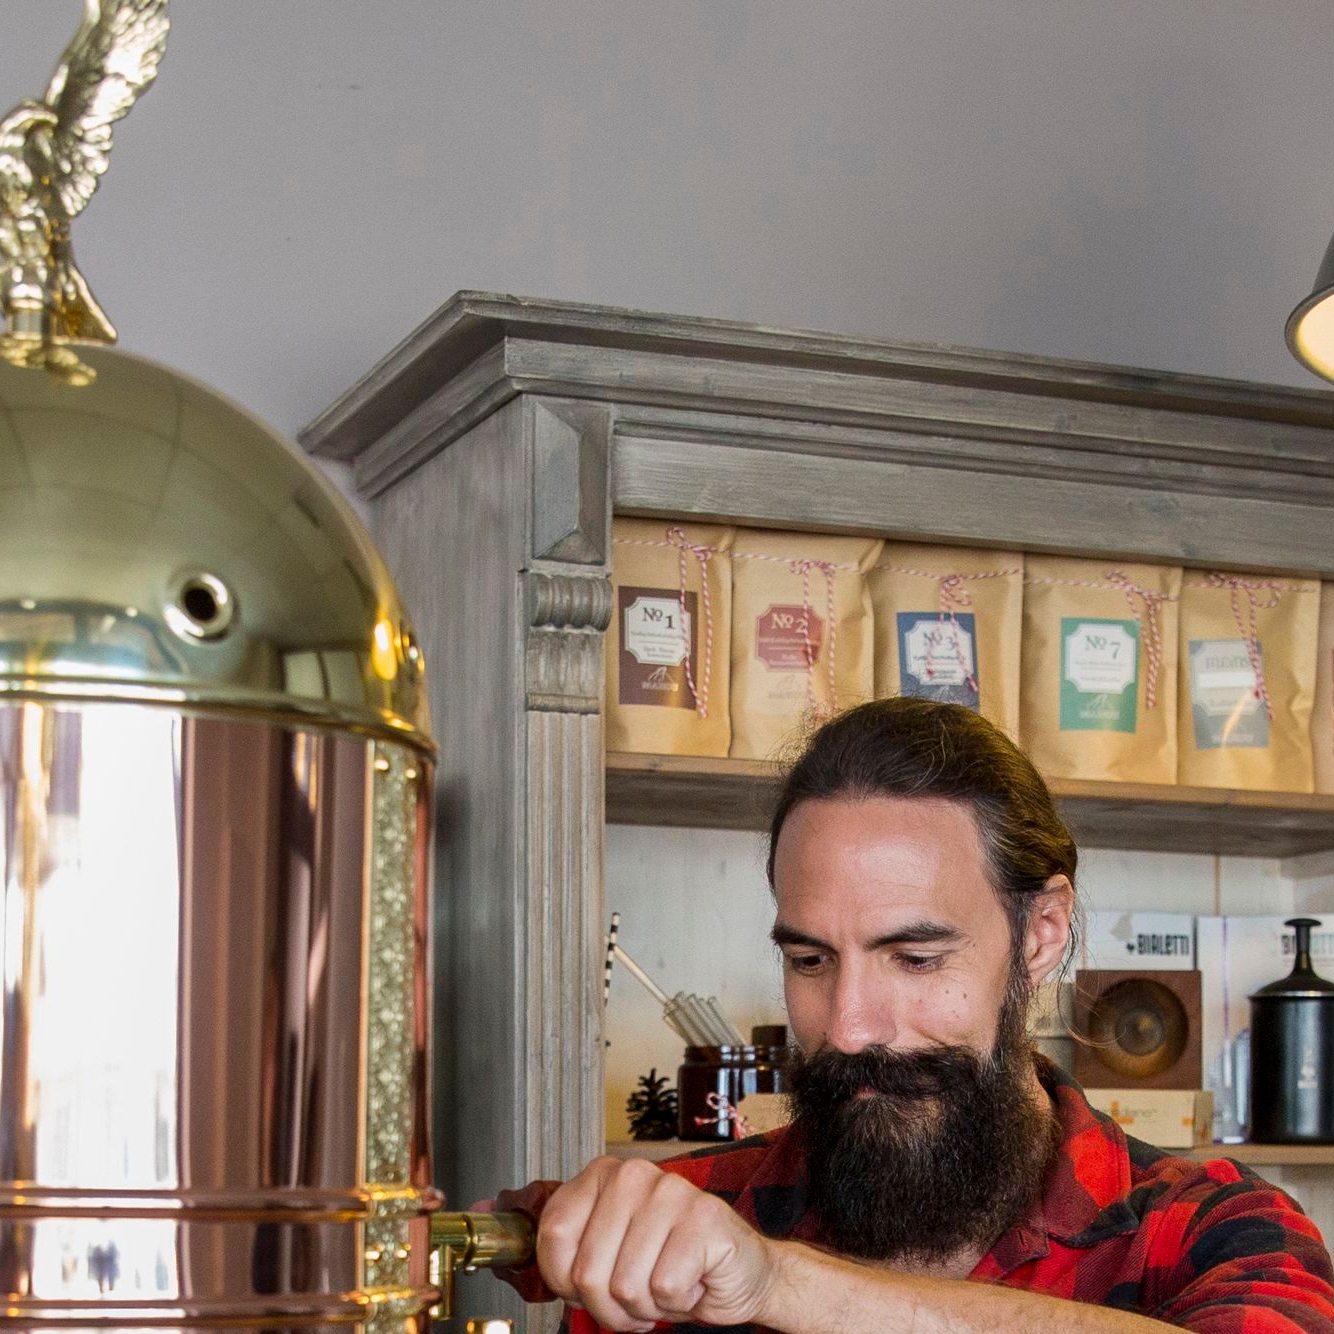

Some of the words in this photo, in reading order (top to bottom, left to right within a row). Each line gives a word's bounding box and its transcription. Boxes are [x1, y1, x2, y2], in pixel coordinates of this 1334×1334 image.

[666, 615, 676, 630] 1
[795, 619, 808, 634] 2
[947, 636, 957, 651] 3
[1110, 641, 1122, 660] 7
[1137, 934, 1189, 956] BIALETTI
